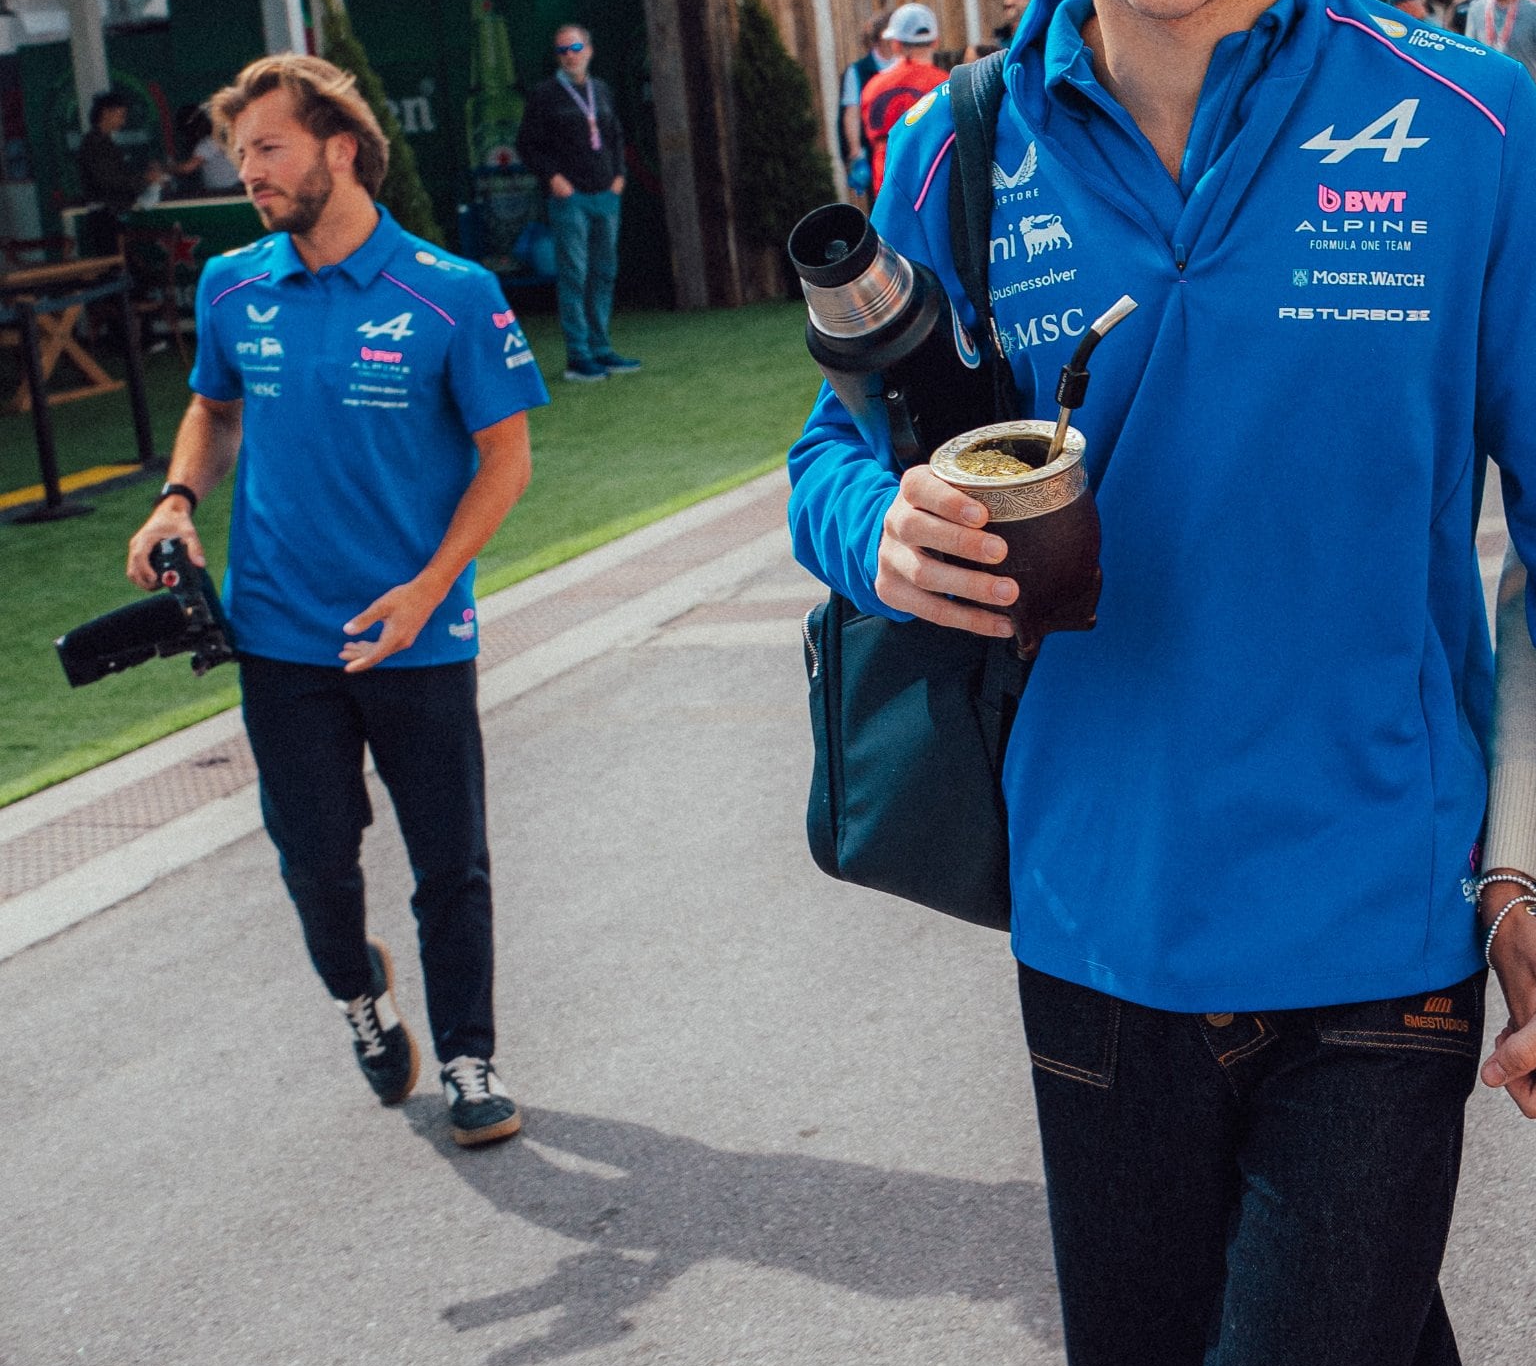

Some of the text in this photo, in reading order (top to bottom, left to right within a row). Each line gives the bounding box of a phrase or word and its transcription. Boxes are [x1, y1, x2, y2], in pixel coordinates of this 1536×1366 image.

[1408, 35, 1446, 51] libre
[1412, 28, 1487, 56] mercado
[995, 187, 1040, 207] STORE
[1344, 190, 1408, 213] BWT
[1294, 219, 1428, 235] ALPINE
[989, 223, 1017, 264] ni
[1309, 239, 1412, 252] FORMULA ONE TEAM
[992, 267, 1078, 302] businessolver
[1014, 307, 1086, 350] MSC
